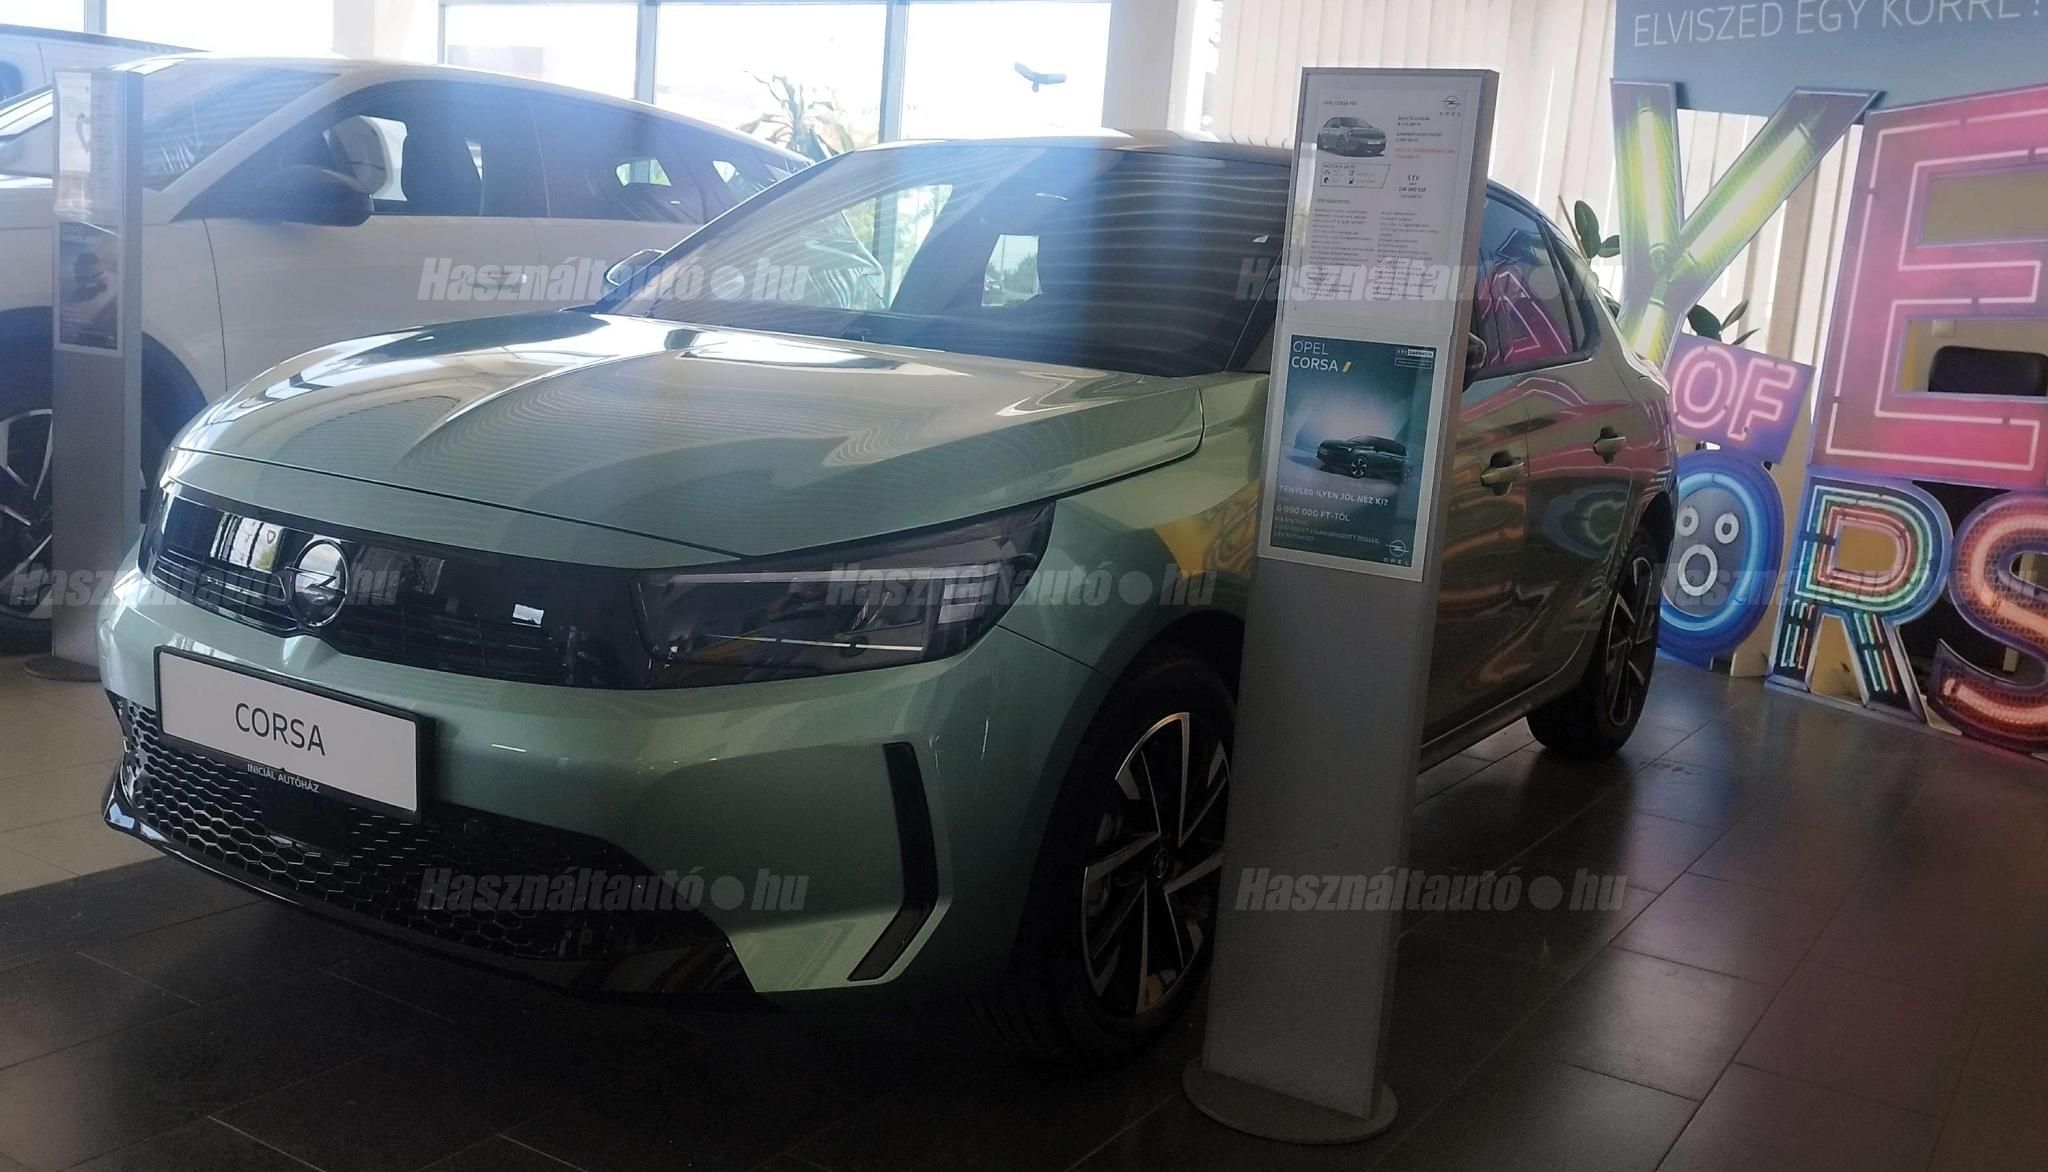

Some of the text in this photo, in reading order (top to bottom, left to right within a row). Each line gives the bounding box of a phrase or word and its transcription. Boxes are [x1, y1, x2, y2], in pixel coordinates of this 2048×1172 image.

[1633, 1, 1784, 47] ELVISZED
[1795, 0, 1865, 35] EGY
[1291, 355, 1339, 373] CORSA
[1293, 340, 1329, 356] OPEL
[1673, 345, 1797, 441] OF
[235, 702, 326, 757] CORSA
